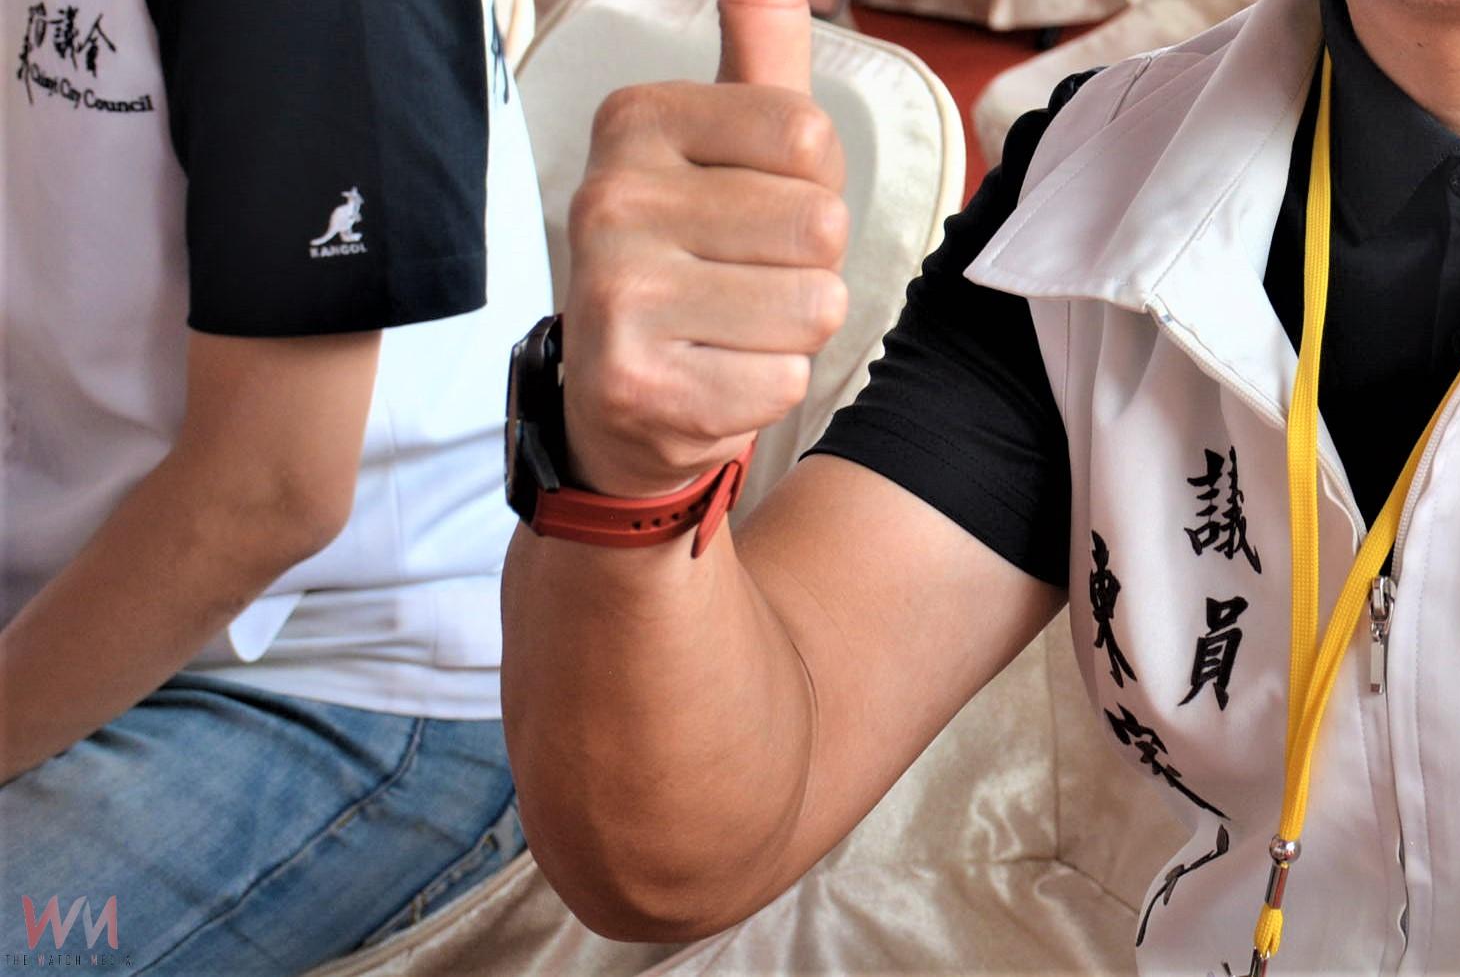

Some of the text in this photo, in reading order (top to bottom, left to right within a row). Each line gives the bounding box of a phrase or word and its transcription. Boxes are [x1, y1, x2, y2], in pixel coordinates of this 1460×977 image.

[83, 89, 154, 113] Council
[309, 243, 368, 259] KANGOL
[1178, 444, 1263, 712] 議員
